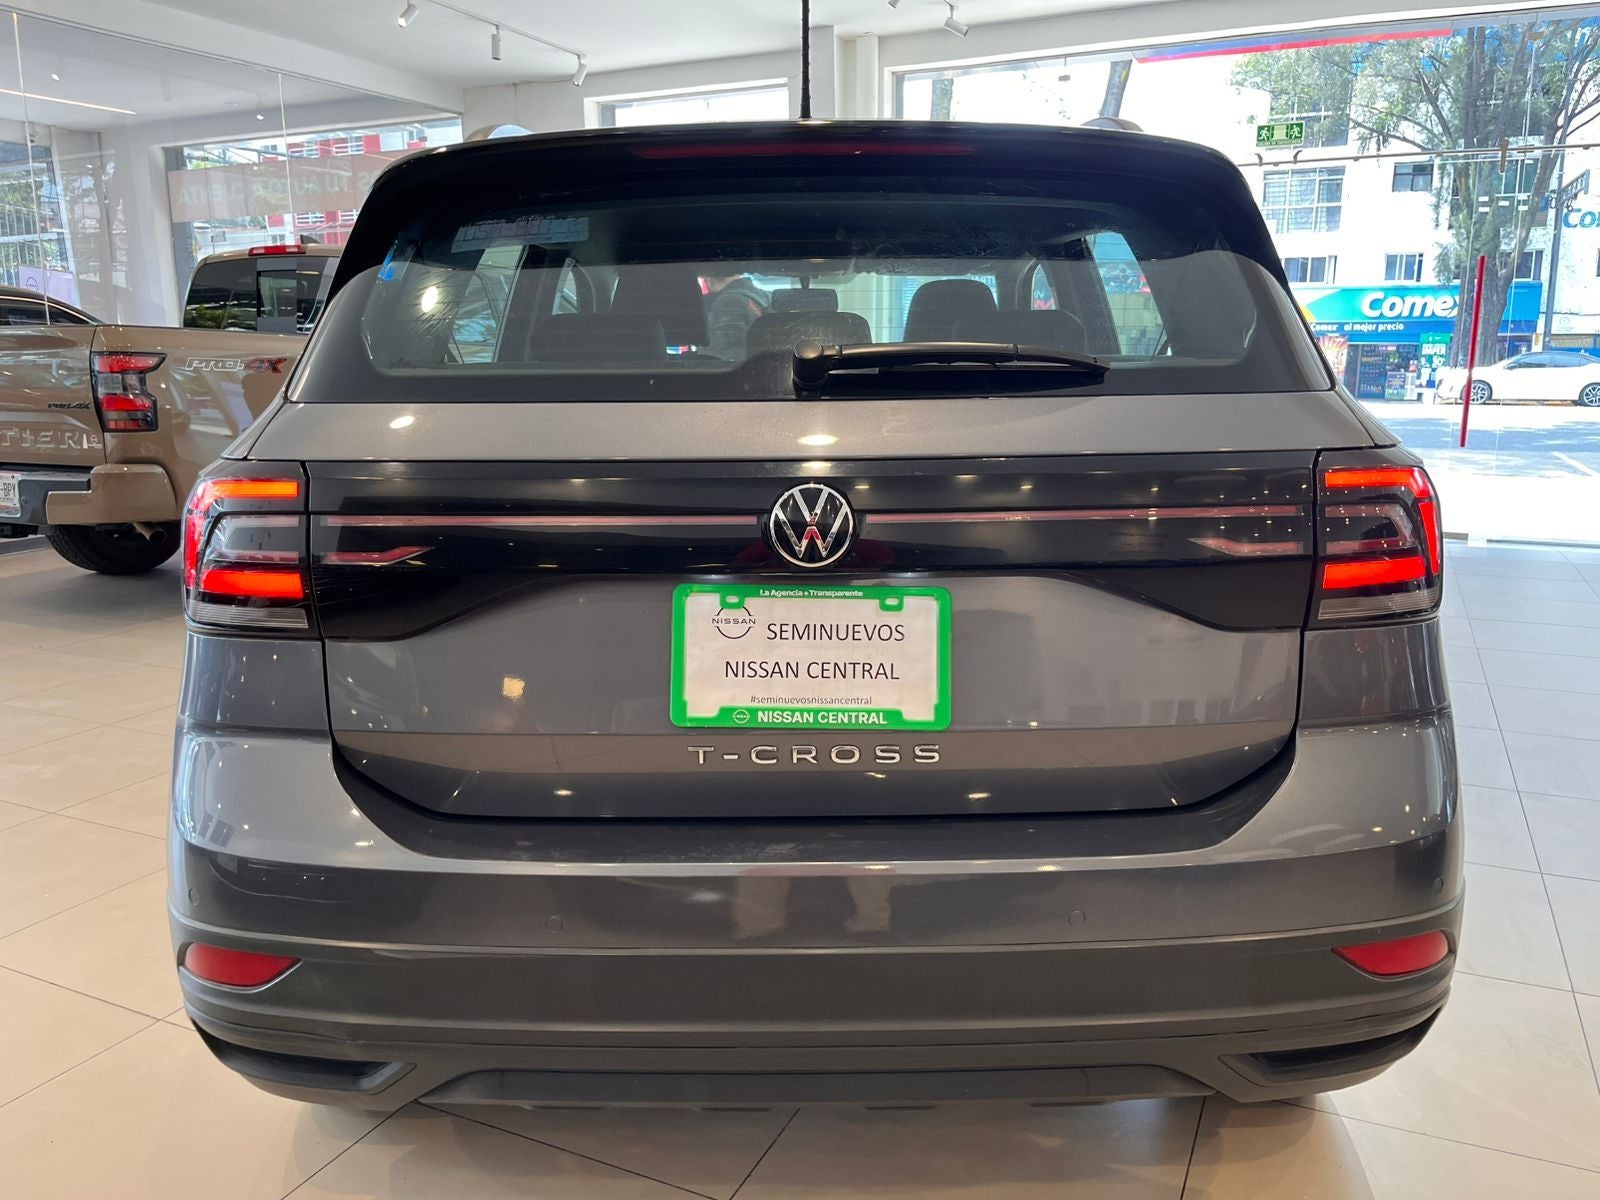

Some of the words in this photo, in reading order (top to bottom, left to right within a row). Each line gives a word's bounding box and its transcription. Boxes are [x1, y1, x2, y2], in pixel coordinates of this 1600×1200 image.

[1563, 207, 1600, 229] Co
[1353, 322, 1376, 333] mejor
[1378, 322, 1405, 333] precio
[771, 589, 804, 598] Agencia
[766, 622, 905, 642] SEMINUEVOS
[725, 660, 799, 679] NISSAN
[806, 661, 900, 681] CENTRAL
[750, 695, 873, 707] #seminuevosnissancentral
[757, 710, 814, 724] NISSAN
[817, 711, 888, 725] CENTRAL
[687, 745, 941, 766] T-CROSS
